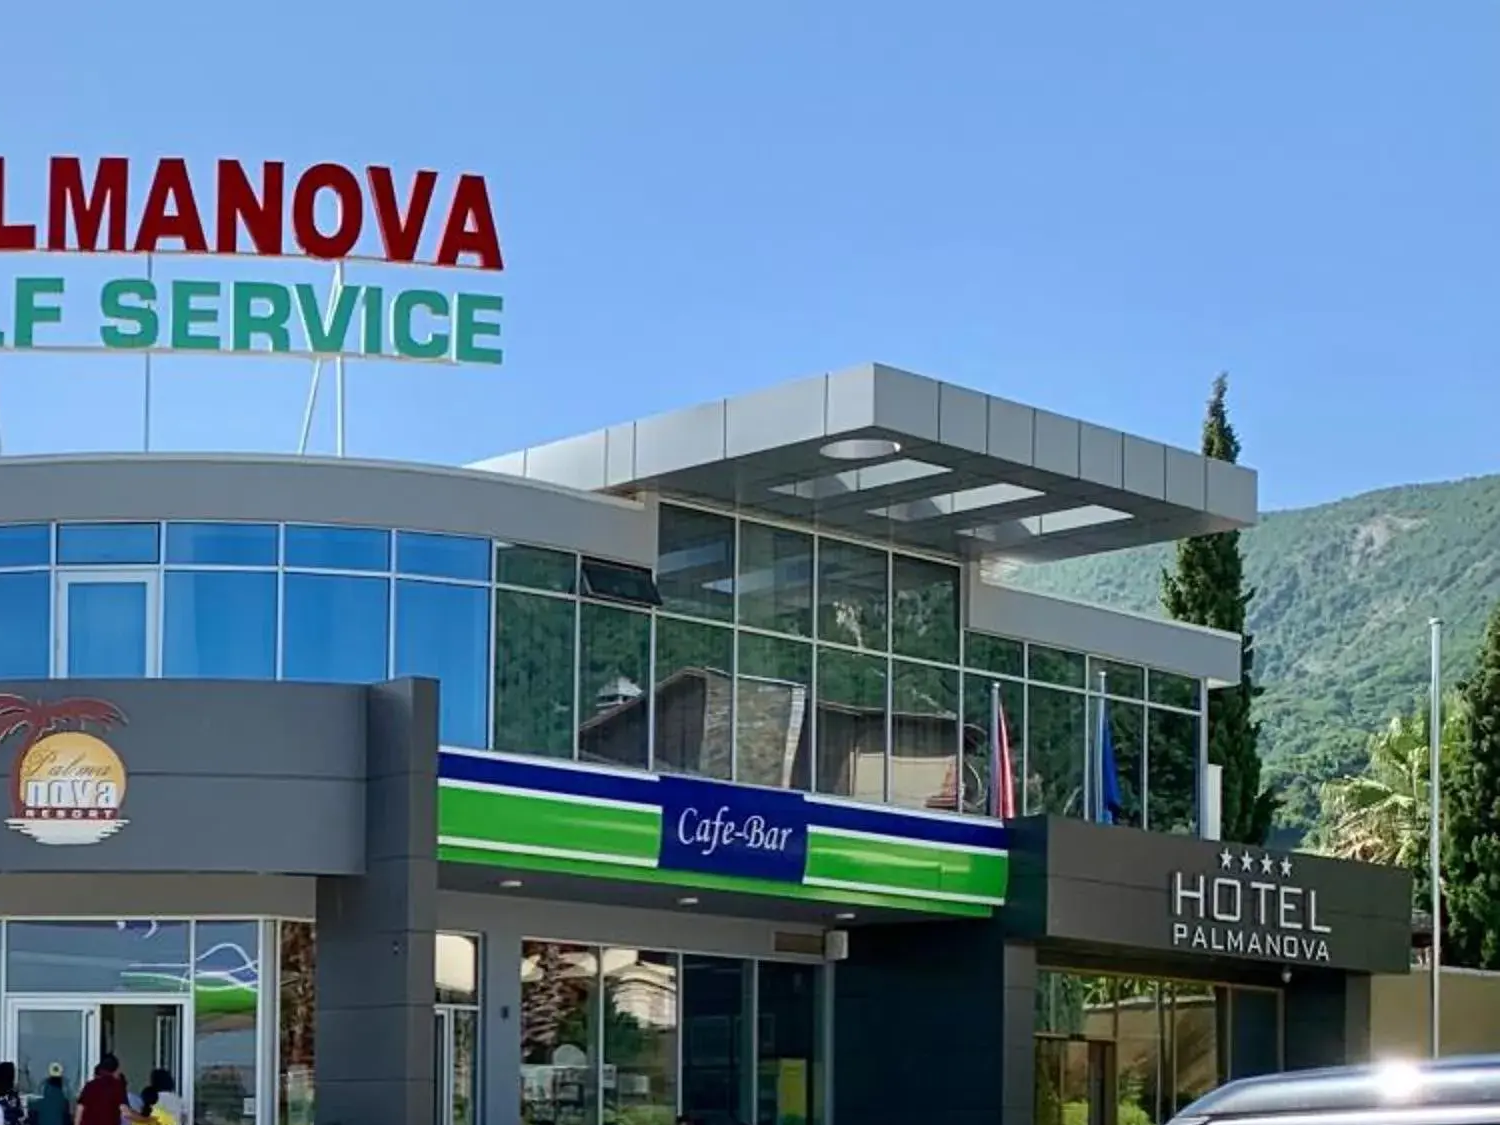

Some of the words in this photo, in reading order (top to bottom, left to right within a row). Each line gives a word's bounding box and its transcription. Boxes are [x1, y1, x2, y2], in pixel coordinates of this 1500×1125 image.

[100, 278, 504, 365] SERVICE
[25, 780, 117, 808] nova
[678, 805, 793, 856] Cafe-Bar
[1173, 871, 1332, 934] HOTEL
[1173, 922, 1330, 962] PALMANOVA
